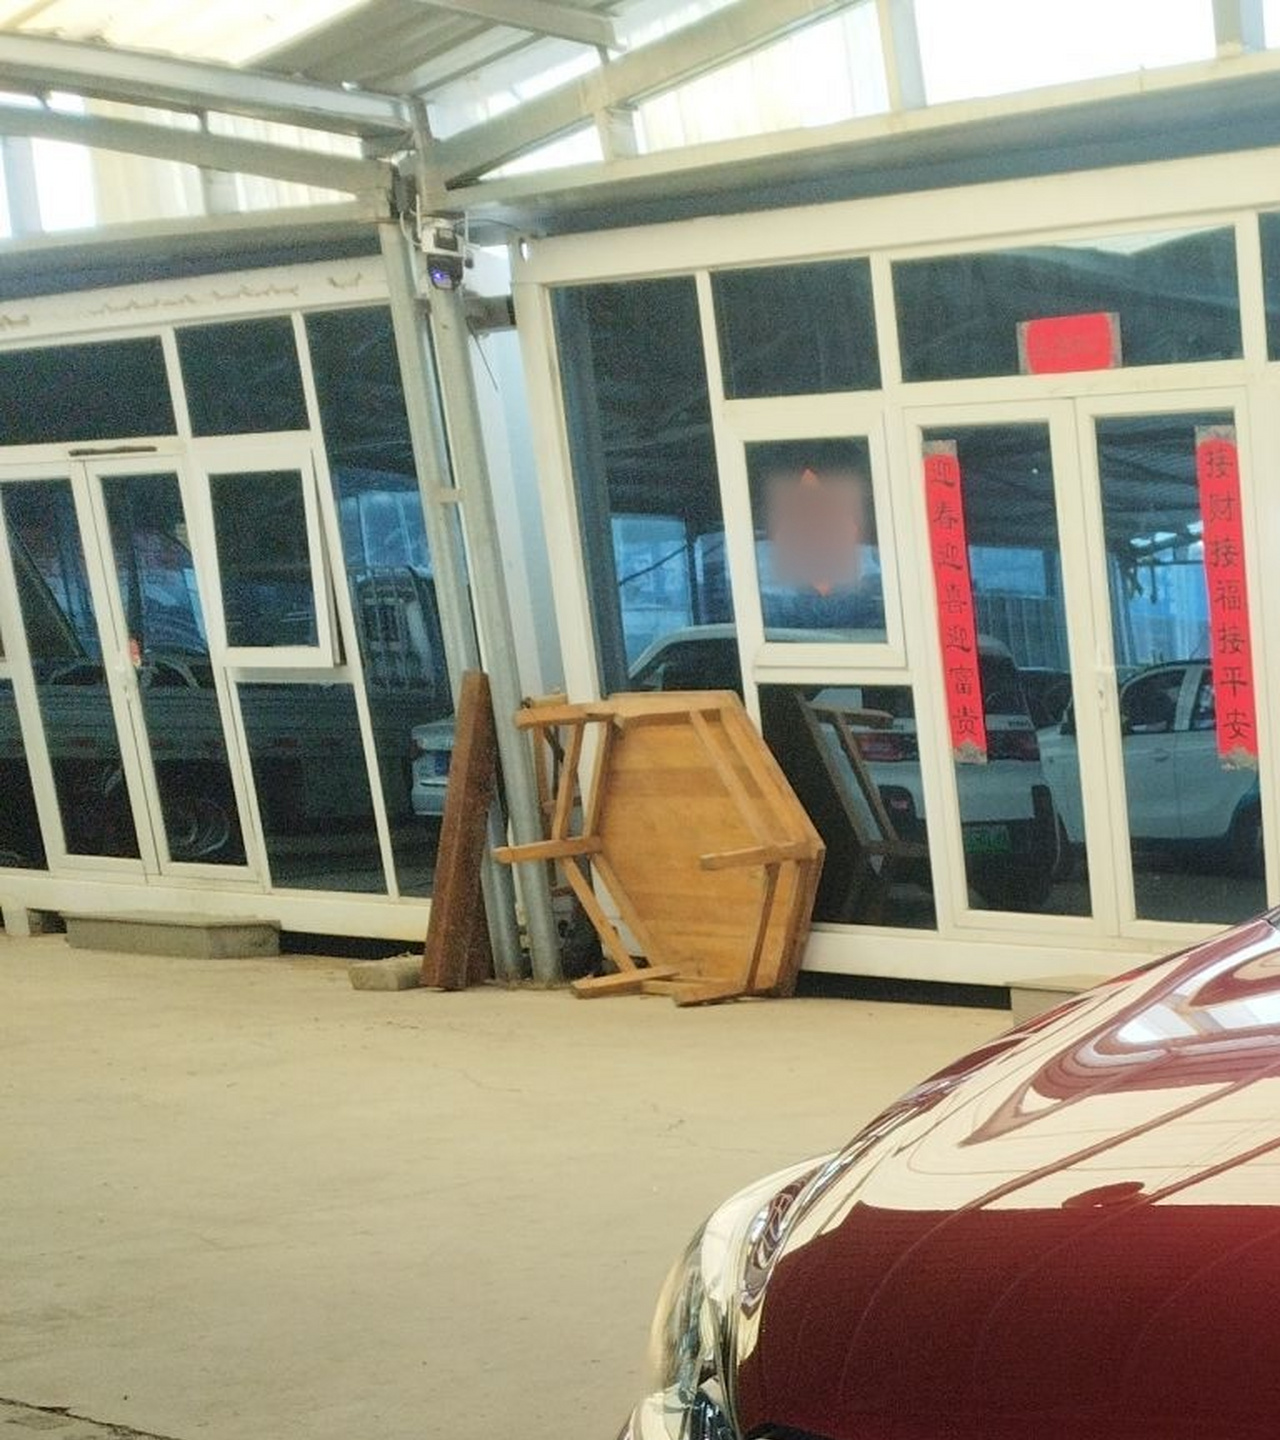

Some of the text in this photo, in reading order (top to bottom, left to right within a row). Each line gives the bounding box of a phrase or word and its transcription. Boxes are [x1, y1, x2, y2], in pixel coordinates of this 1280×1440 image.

[1206, 449, 1251, 740] 接财接福接平安
